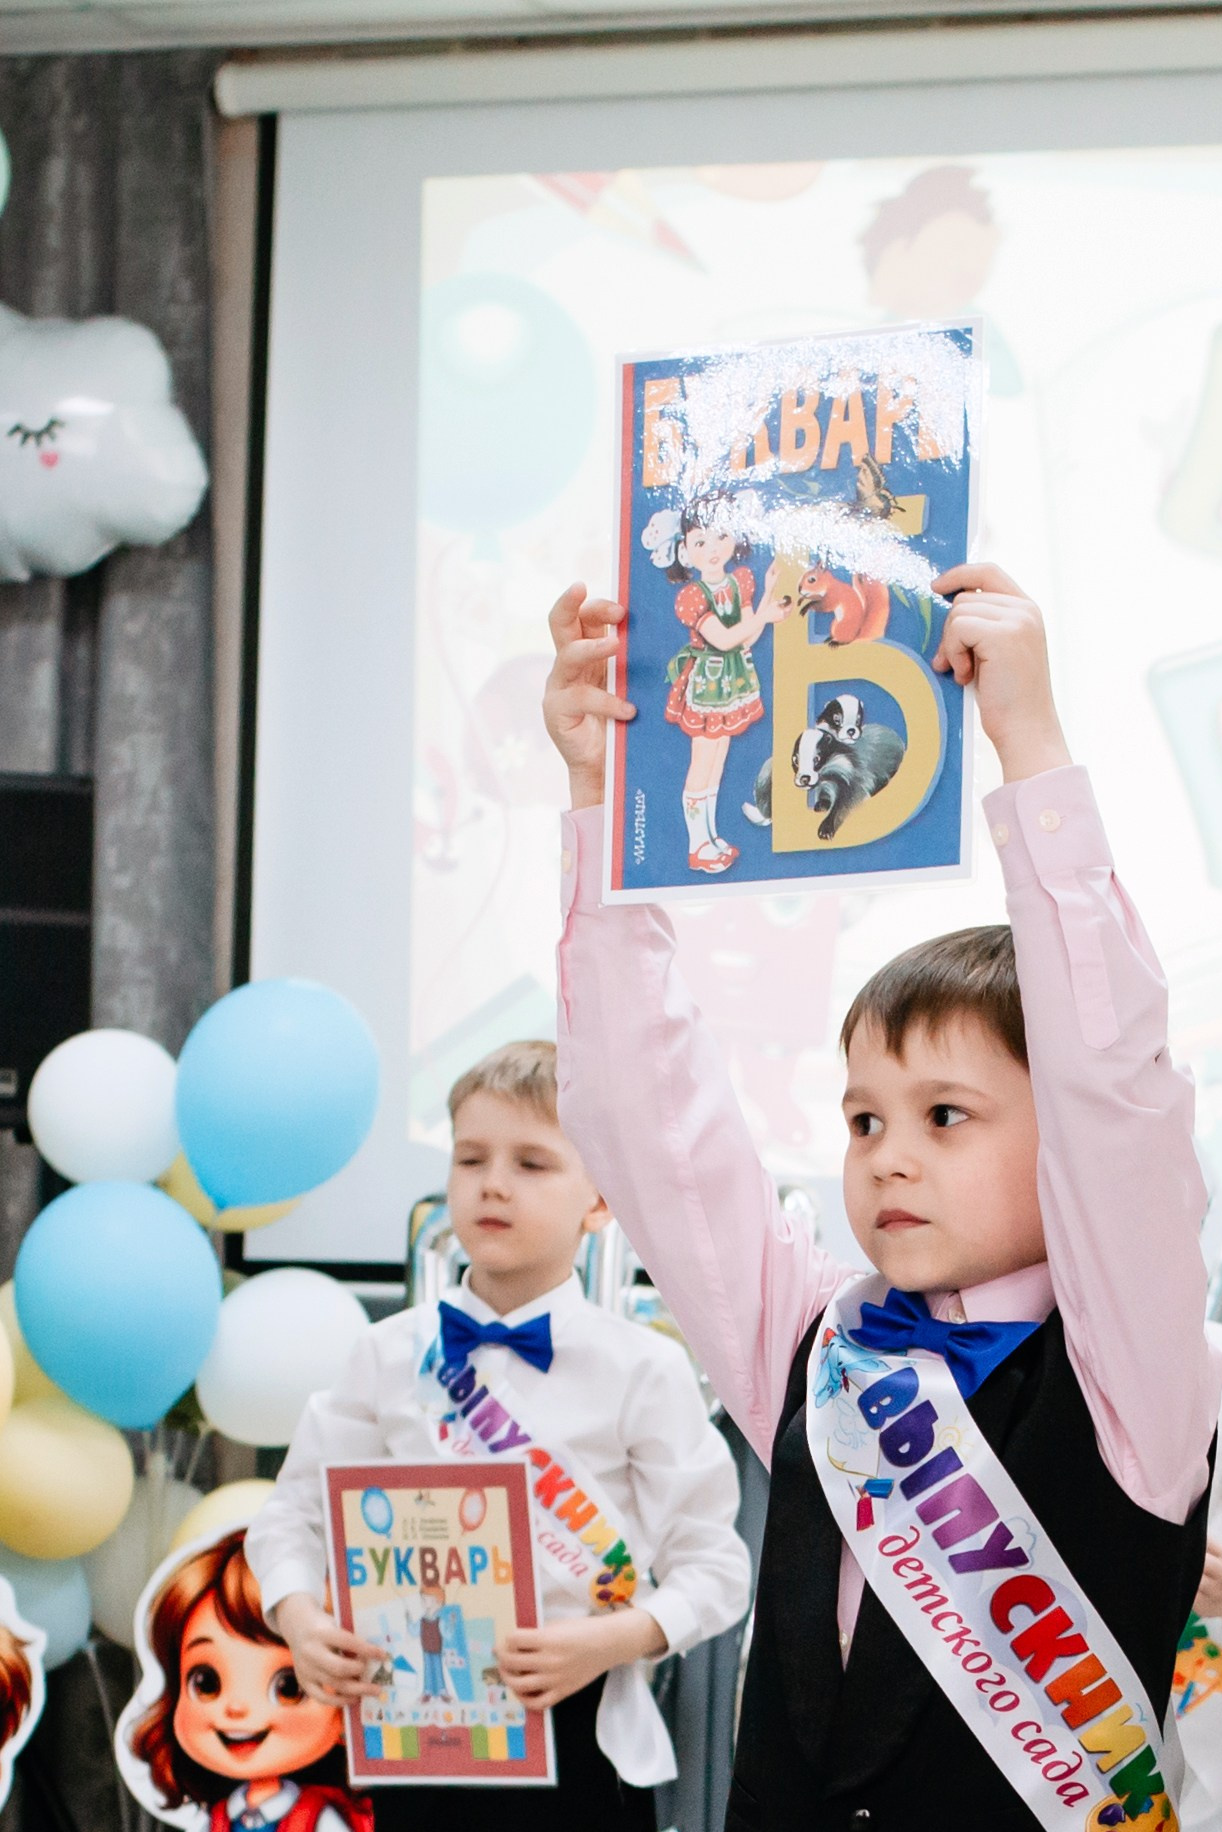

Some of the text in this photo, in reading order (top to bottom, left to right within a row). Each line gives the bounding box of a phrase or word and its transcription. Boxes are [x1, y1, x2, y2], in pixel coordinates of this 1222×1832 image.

[345, 1545, 514, 1587] БУКВАРЬ
[857, 1366, 1165, 1822] ВЫПУСКНИК
[876, 1524, 1094, 1808] детского сада
